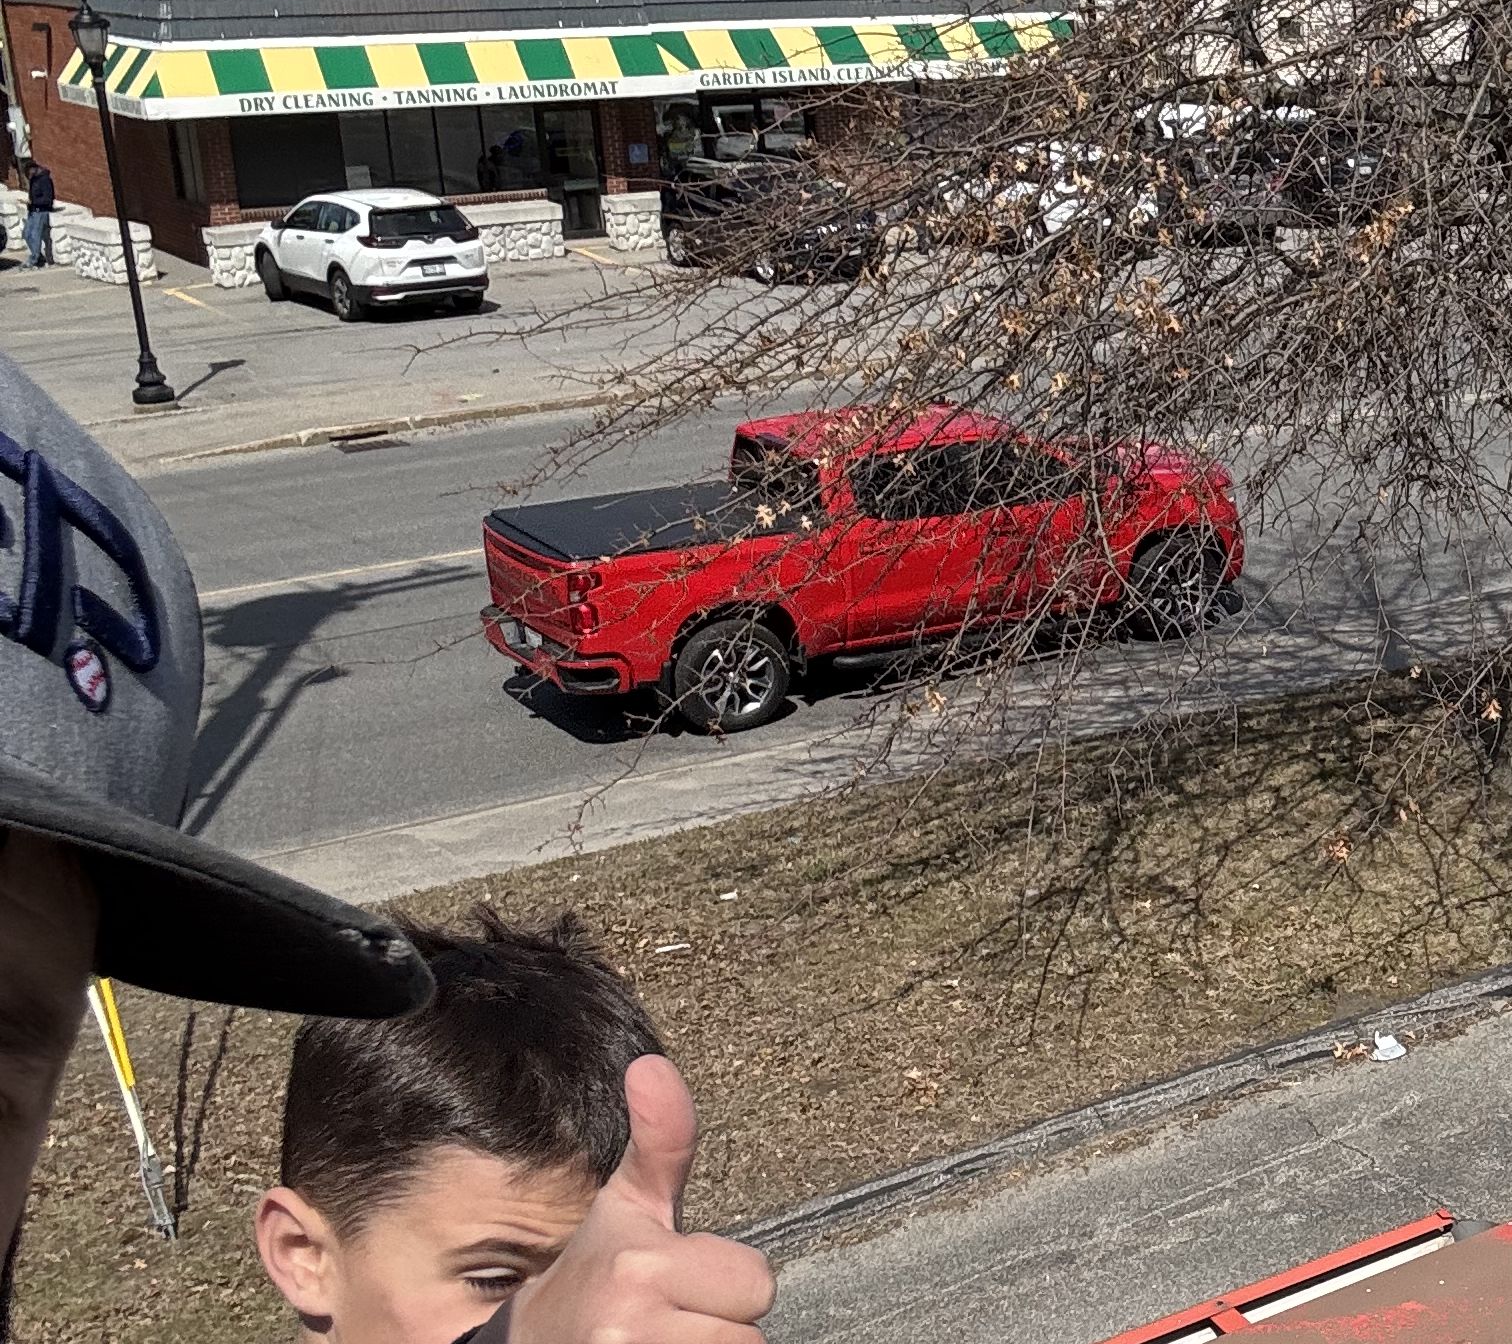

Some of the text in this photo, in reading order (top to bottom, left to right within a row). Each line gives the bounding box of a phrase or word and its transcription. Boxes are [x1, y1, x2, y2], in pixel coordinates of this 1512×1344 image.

[699, 71, 766, 87] GARDEN
[772, 67, 831, 83] ISLAND
[239, 80, 618, 113] DRY CLEANING TANNING LAUNDROMAT
